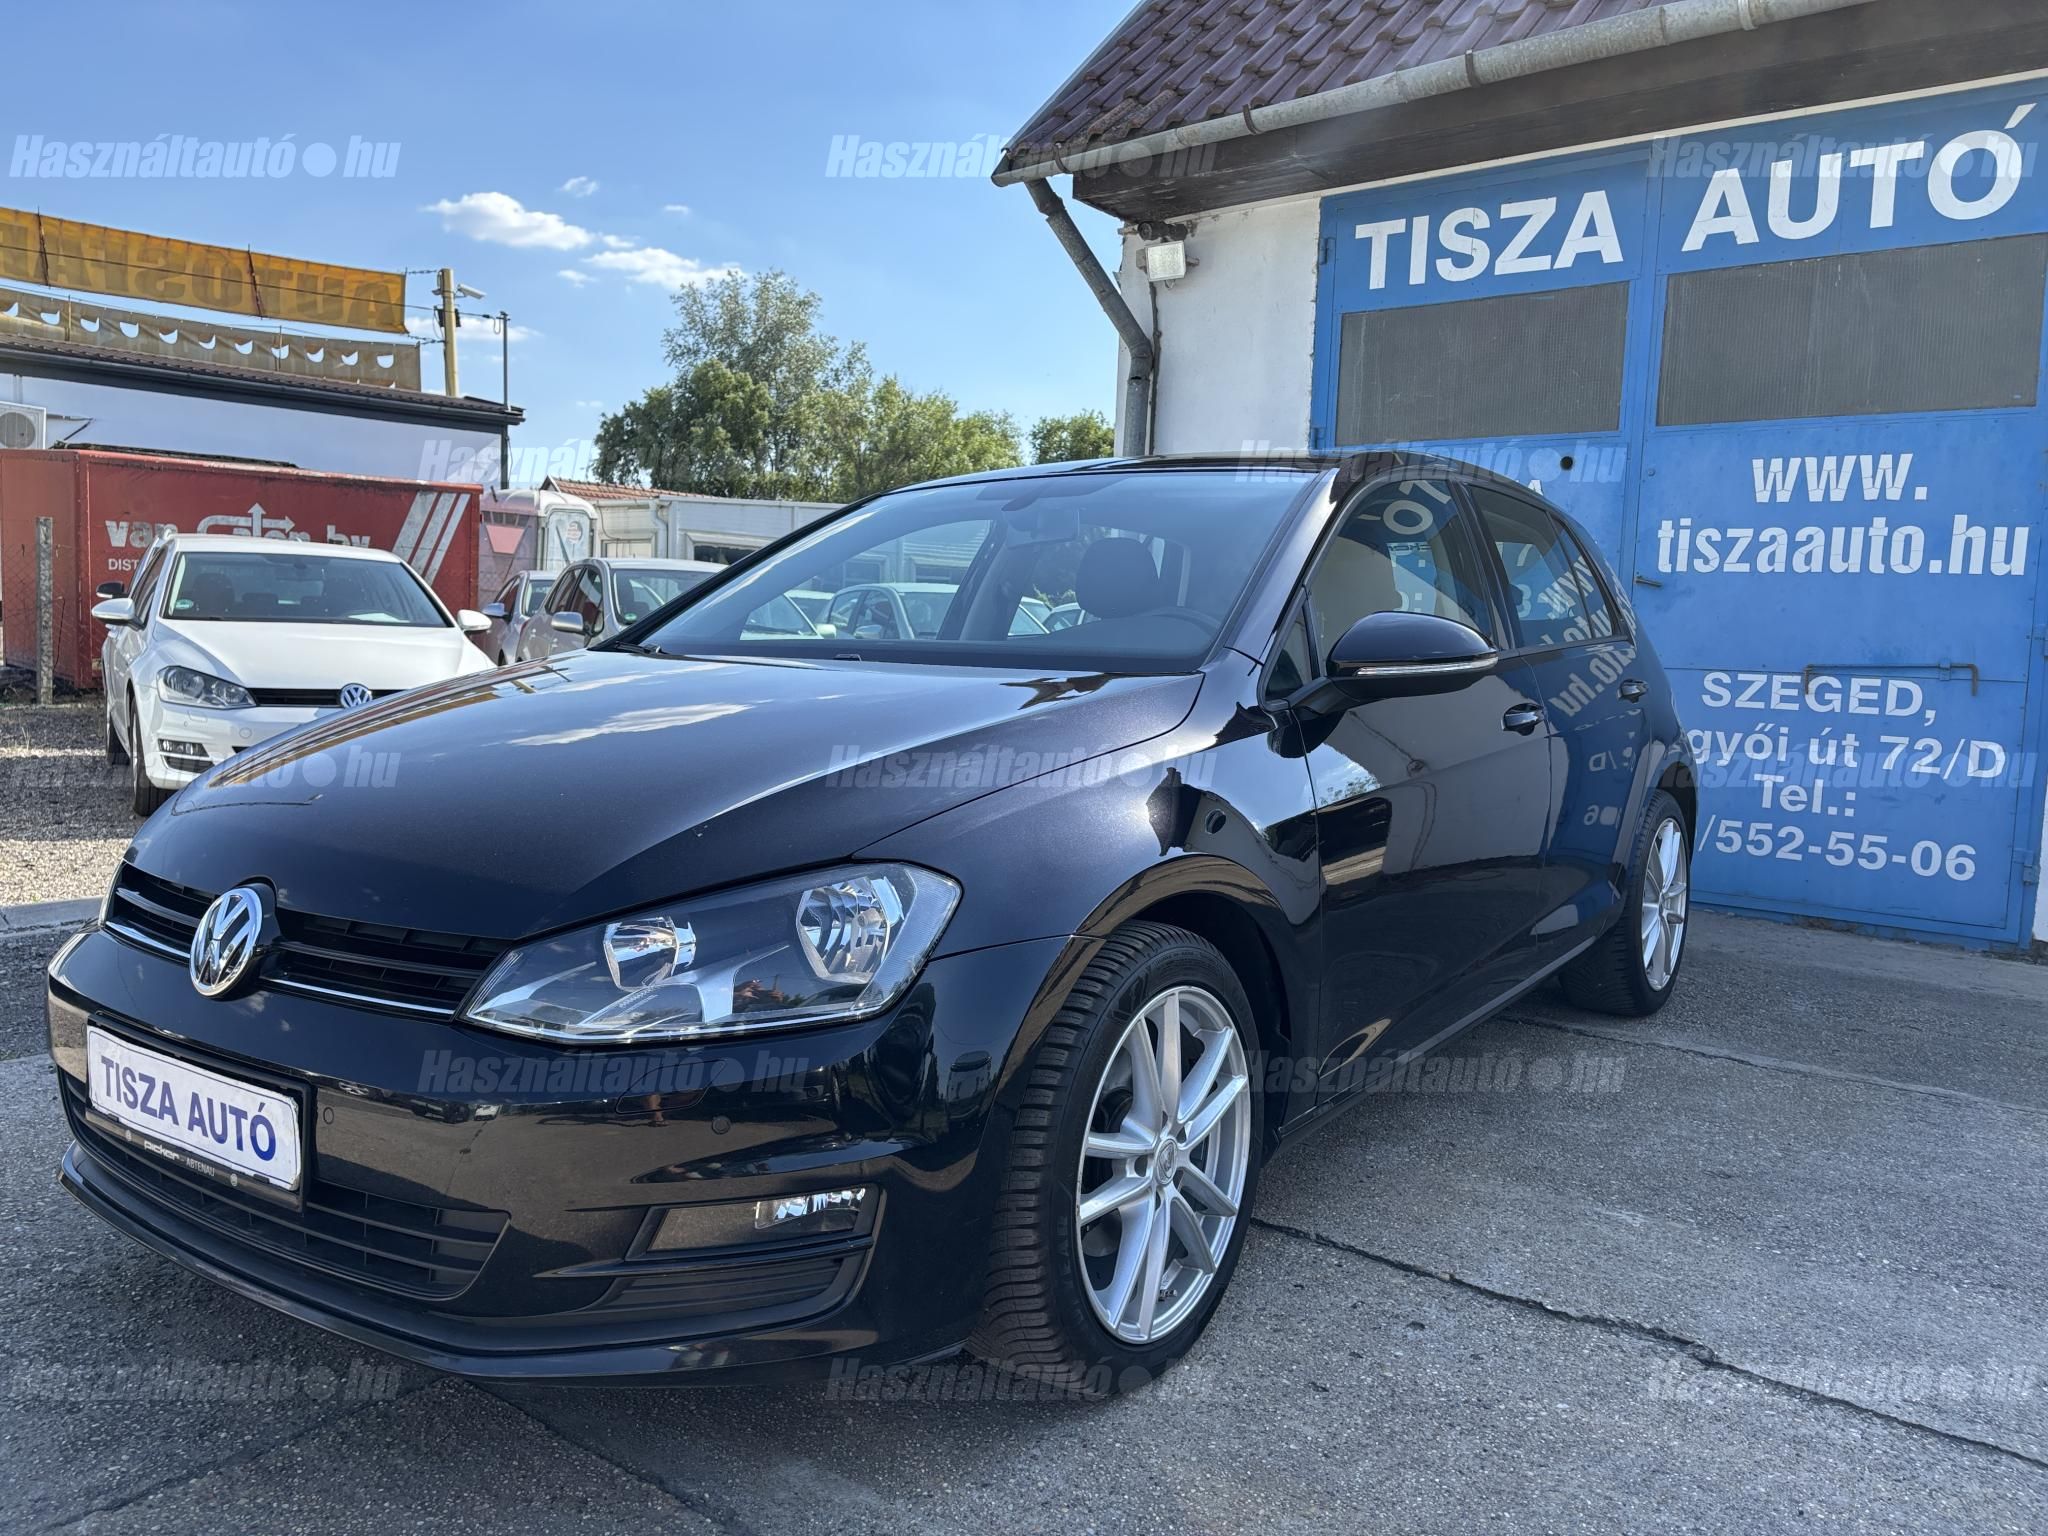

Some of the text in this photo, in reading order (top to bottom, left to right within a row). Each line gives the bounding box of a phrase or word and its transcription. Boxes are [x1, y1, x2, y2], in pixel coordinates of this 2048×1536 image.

[1355, 103, 2037, 290] TISZA AUTÓ
[1751, 452, 1928, 503] www.
[1657, 514, 2030, 576] tiszaauto.hu
[1701, 671, 1937, 727] SZEGED,
[1686, 722, 2006, 780] győi út 72/D
[1753, 773, 1856, 817] Tel.:
[1698, 814, 1977, 882] /552-55-06
[101, 1055, 277, 1162] TISZA AUTÓ
